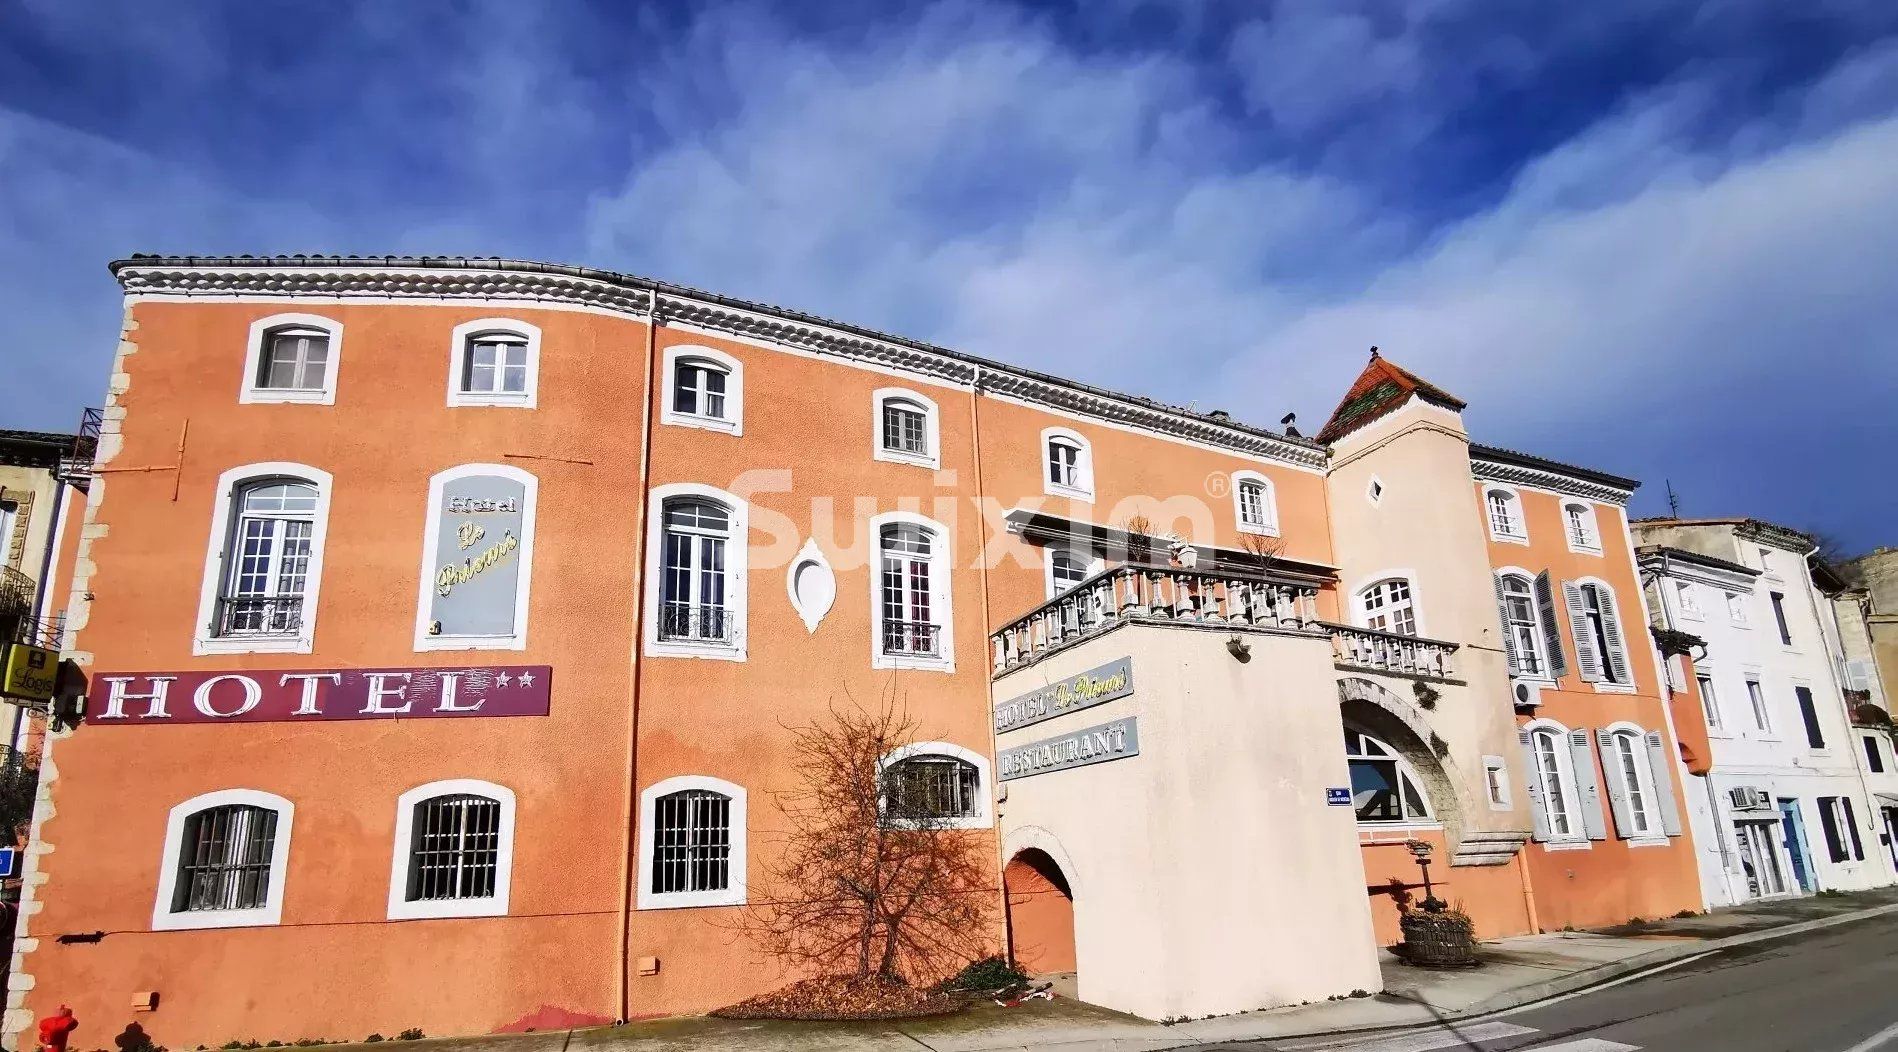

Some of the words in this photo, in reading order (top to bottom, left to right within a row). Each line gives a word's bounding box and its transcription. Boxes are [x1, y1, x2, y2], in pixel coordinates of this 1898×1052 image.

[456, 520, 486, 551] Le
[12, 667, 53, 695] Logis
[96, 671, 488, 719] HOTEL
[995, 692, 1048, 731] HOTEL
[1002, 721, 1127, 777] RESTAURANT
